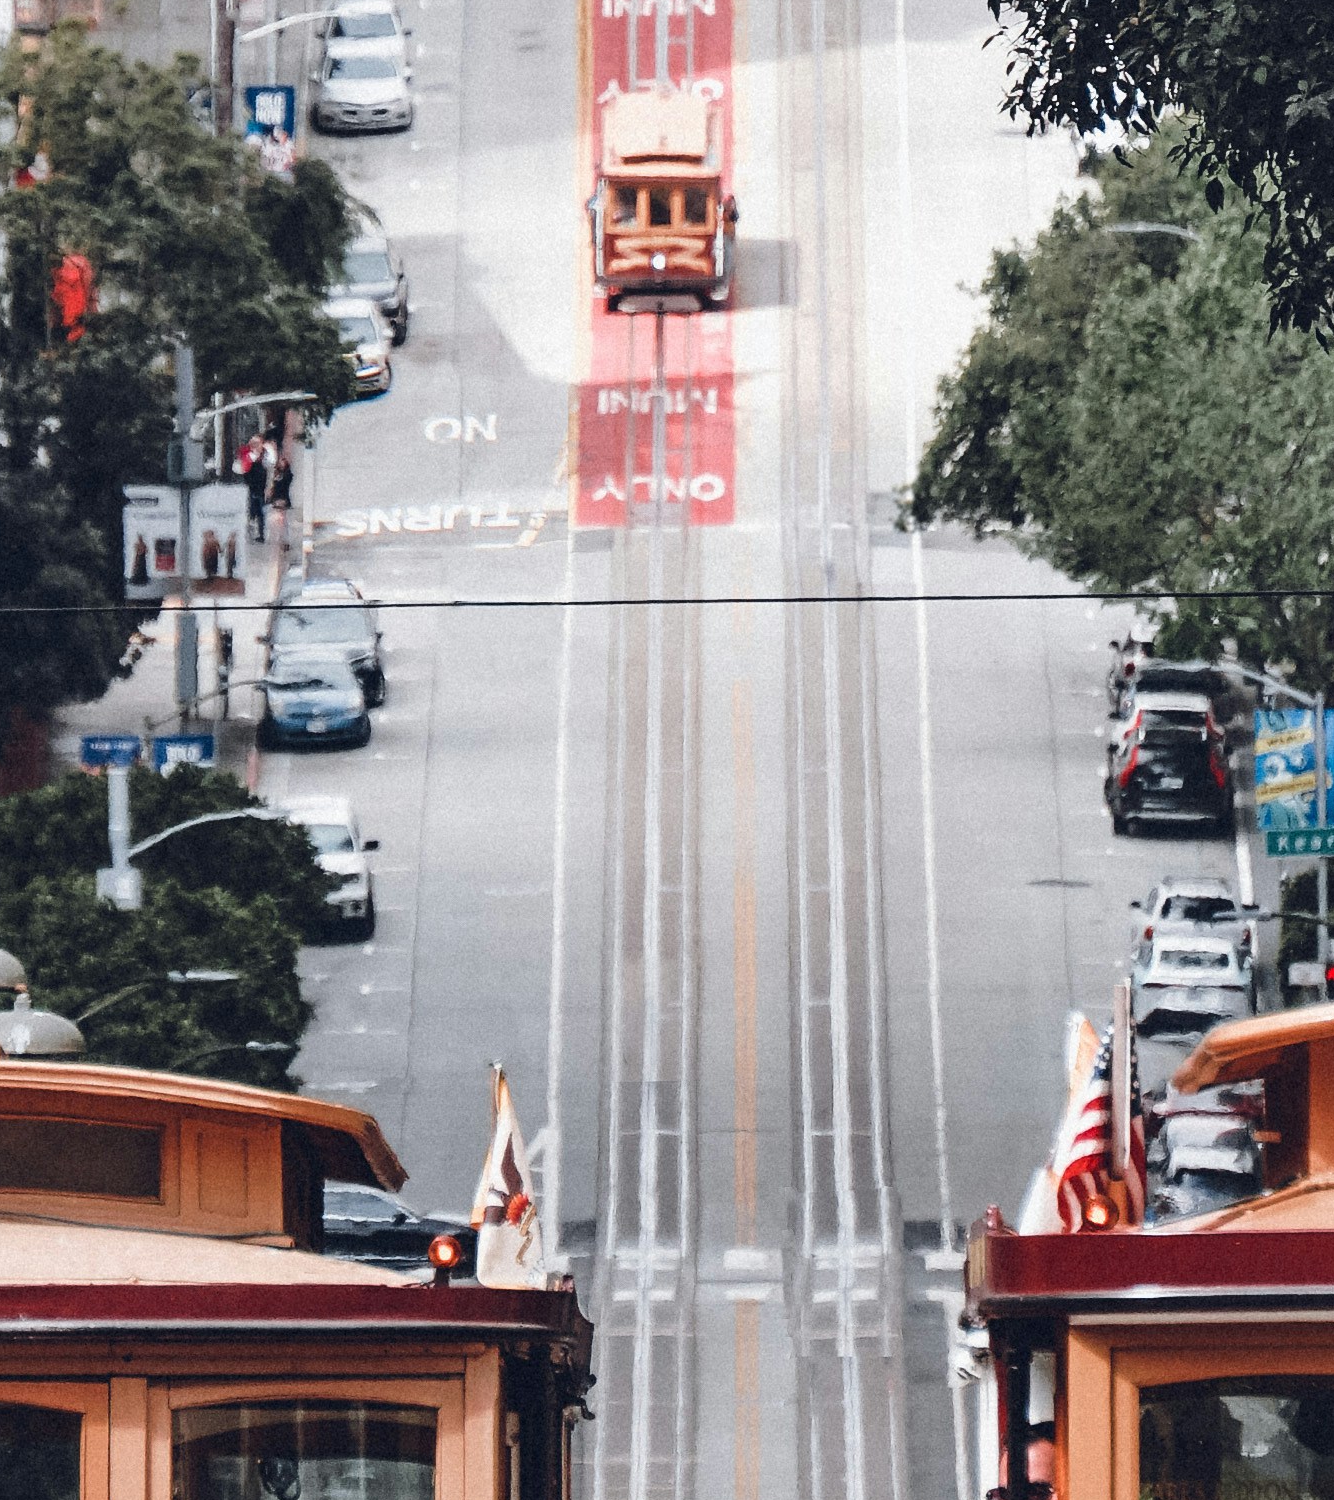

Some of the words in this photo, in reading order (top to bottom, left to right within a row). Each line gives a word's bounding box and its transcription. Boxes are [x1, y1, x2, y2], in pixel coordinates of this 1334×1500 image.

[423, 414, 498, 442] NO
[592, 472, 726, 502] ONLY
[337, 503, 522, 536] TURNS
